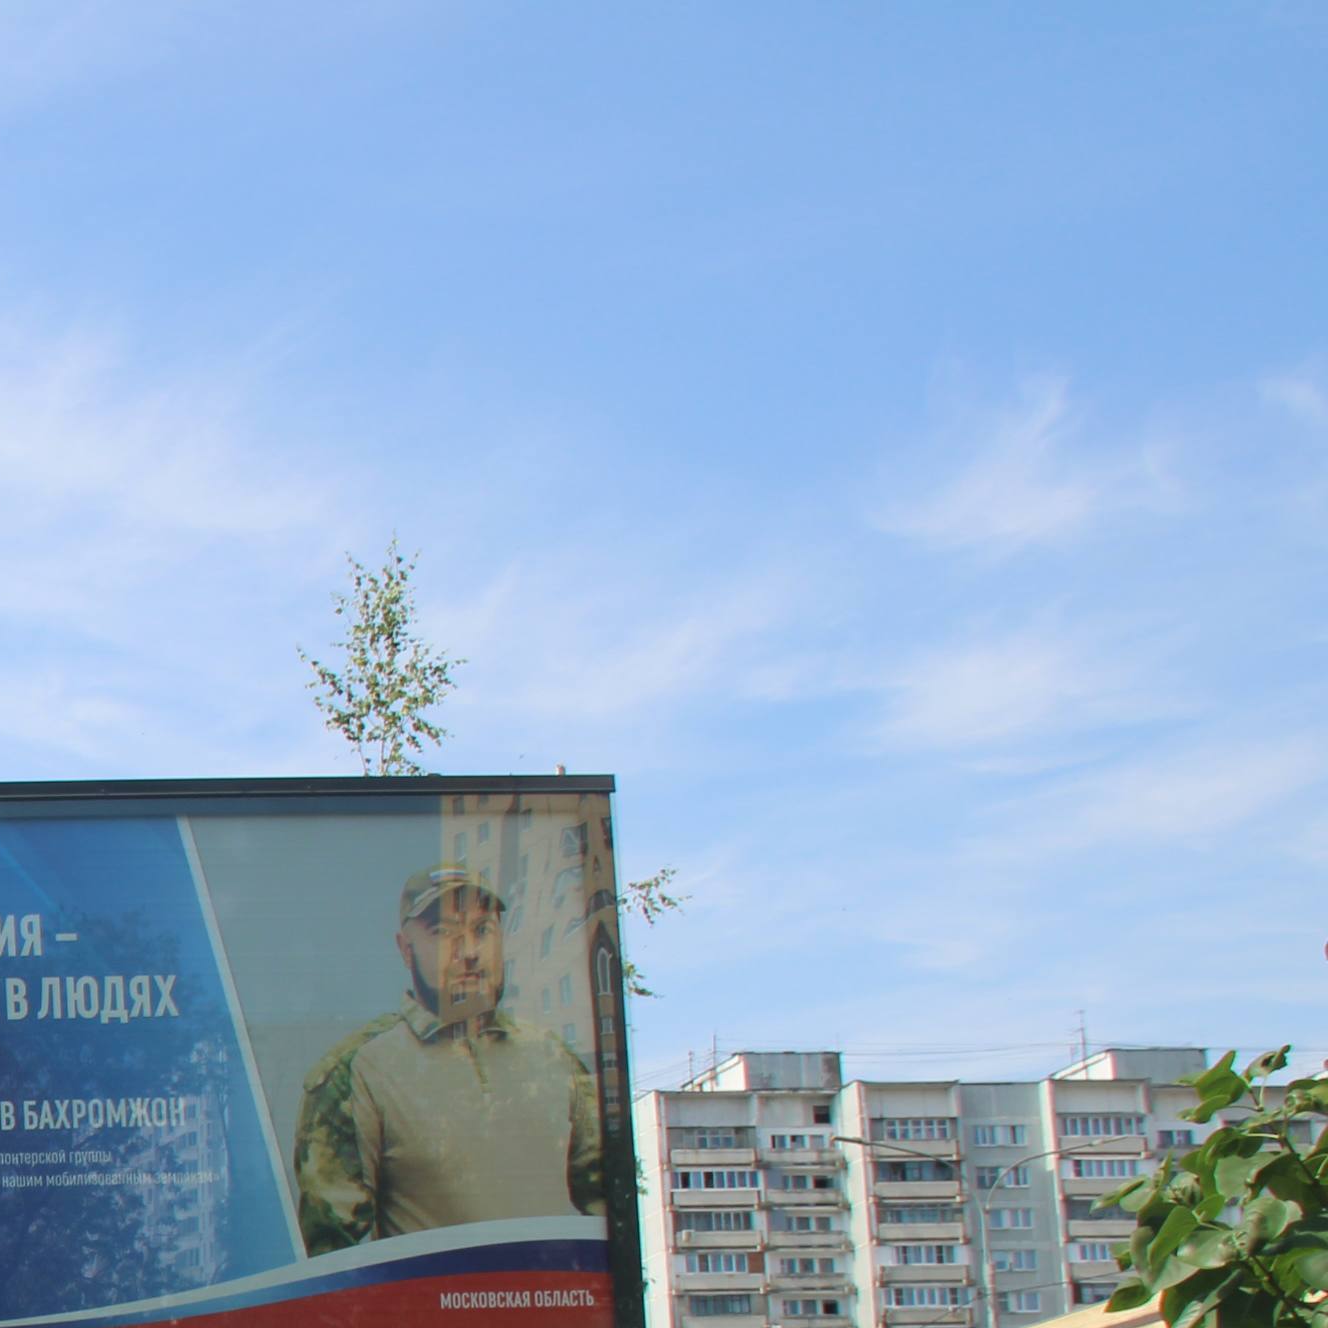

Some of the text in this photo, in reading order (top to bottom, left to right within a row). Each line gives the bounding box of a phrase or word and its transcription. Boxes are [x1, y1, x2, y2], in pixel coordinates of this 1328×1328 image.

[5, 977, 29, 1020] В
[37, 974, 180, 1024] ЛЮДЯХ
[23, 1097, 185, 1130] БАХРОМЖОН
[69, 1150, 112, 1166] группы
[2, 1174, 43, 1188] нашим
[46, 1171, 152, 1187] мобилизованным
[440, 1289, 595, 1309] МОСКОВСКАЯ ОБЛАСТЬ
